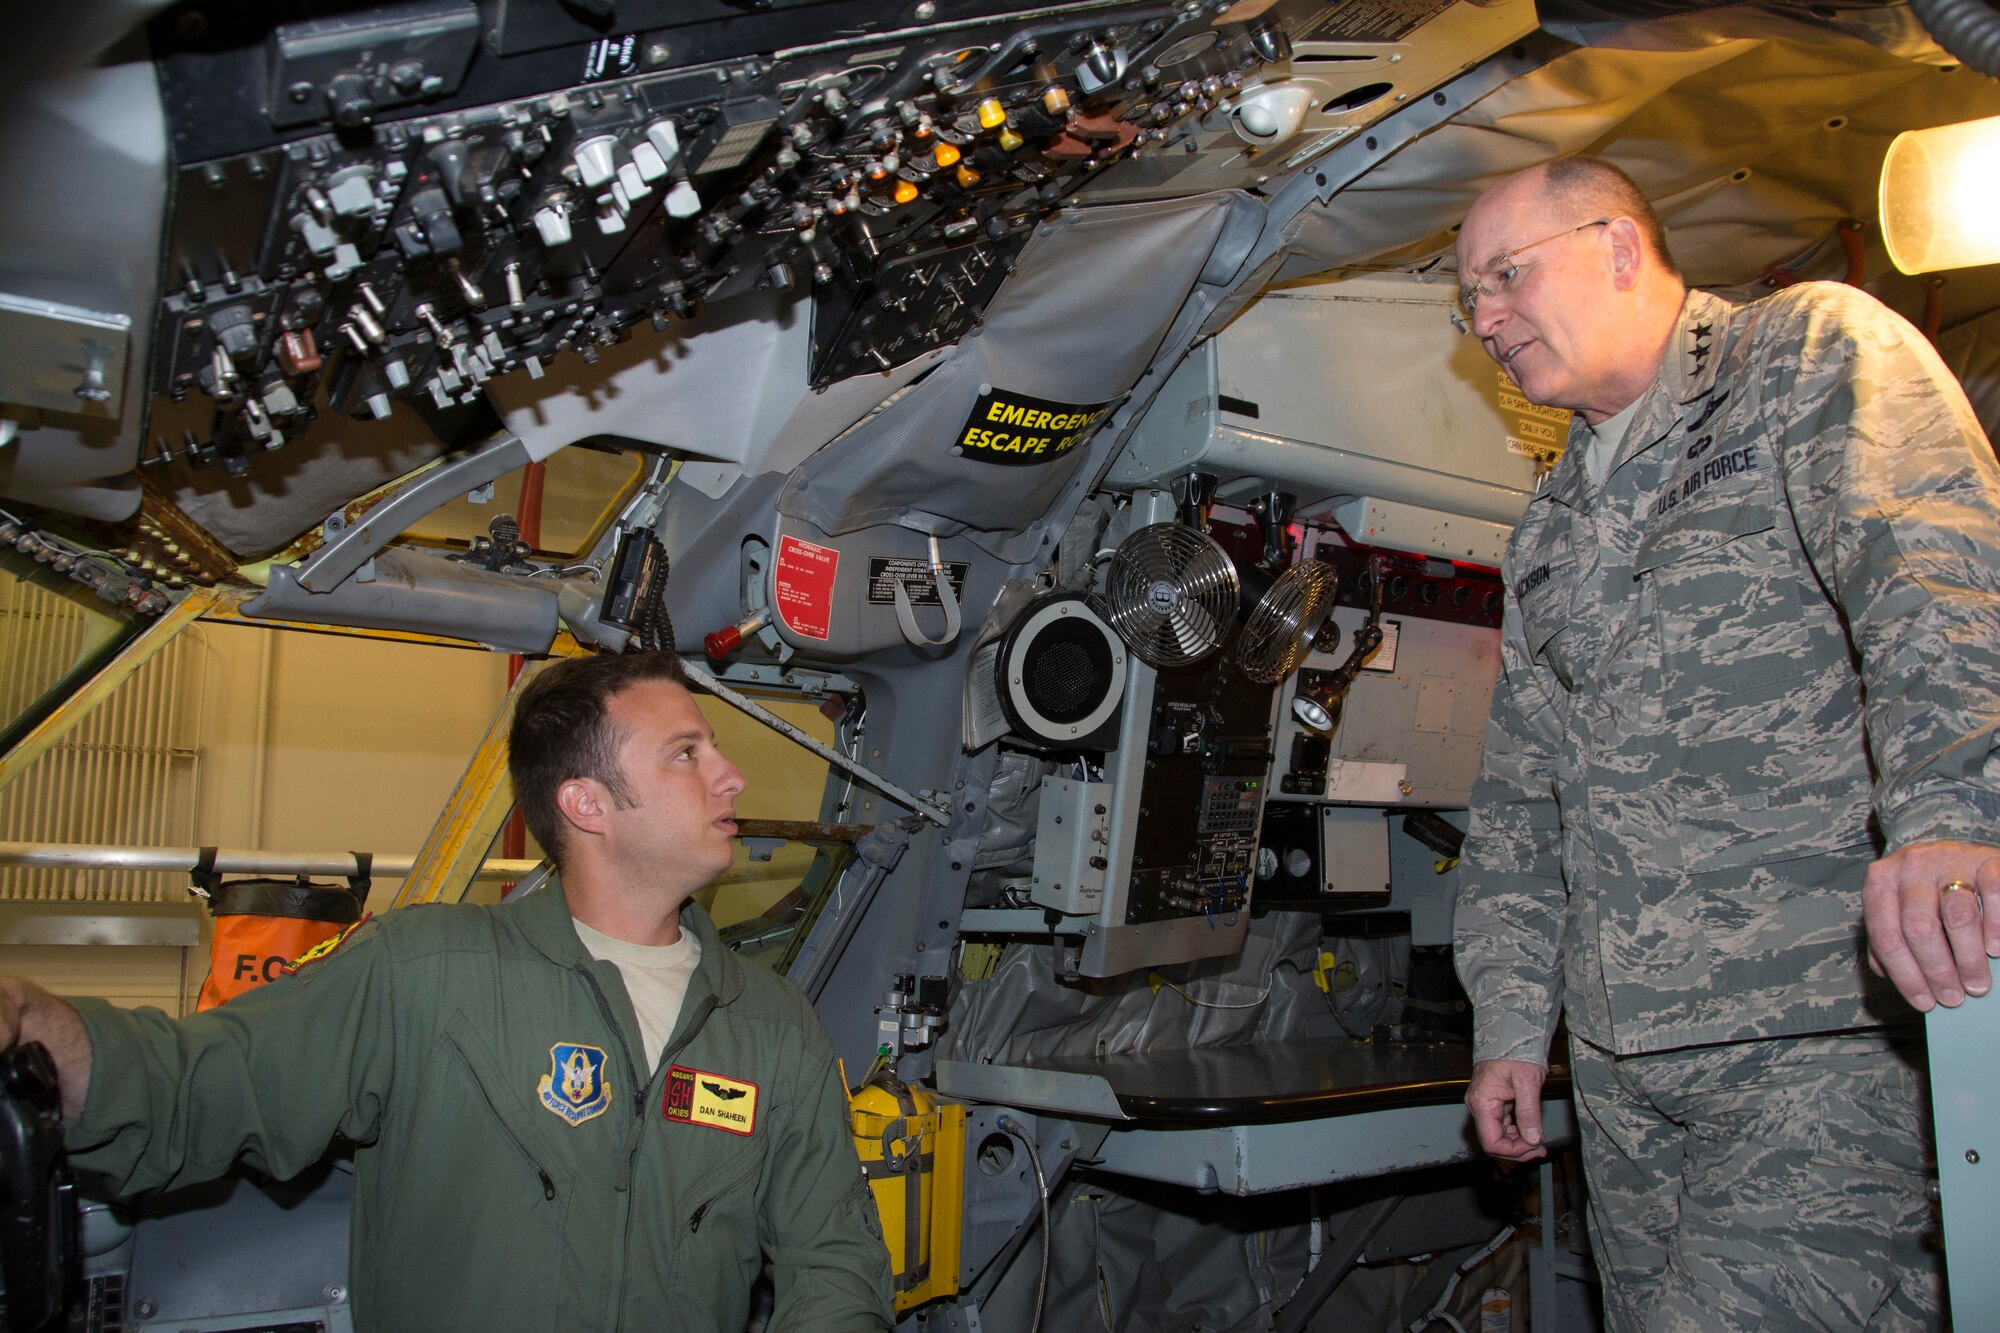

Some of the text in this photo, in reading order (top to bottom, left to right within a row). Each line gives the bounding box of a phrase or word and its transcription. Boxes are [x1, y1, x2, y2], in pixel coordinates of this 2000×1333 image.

[1514, 399, 1530, 411] SAFE
[1520, 422, 1556, 439] ONLY YOU
[963, 427, 1051, 454] ESCAPE
[1508, 439, 1522, 451] CAN
[1657, 446, 1758, 516] U.S. AIR FORCE
[788, 546, 830, 564] CROSS-OVER VALVE
[798, 542, 822, 554] HYDRAULIC
[671, 1081, 691, 1107] SH
[668, 1107, 689, 1118] OKIES
[700, 1106, 747, 1123] DAN SHAHEEN
